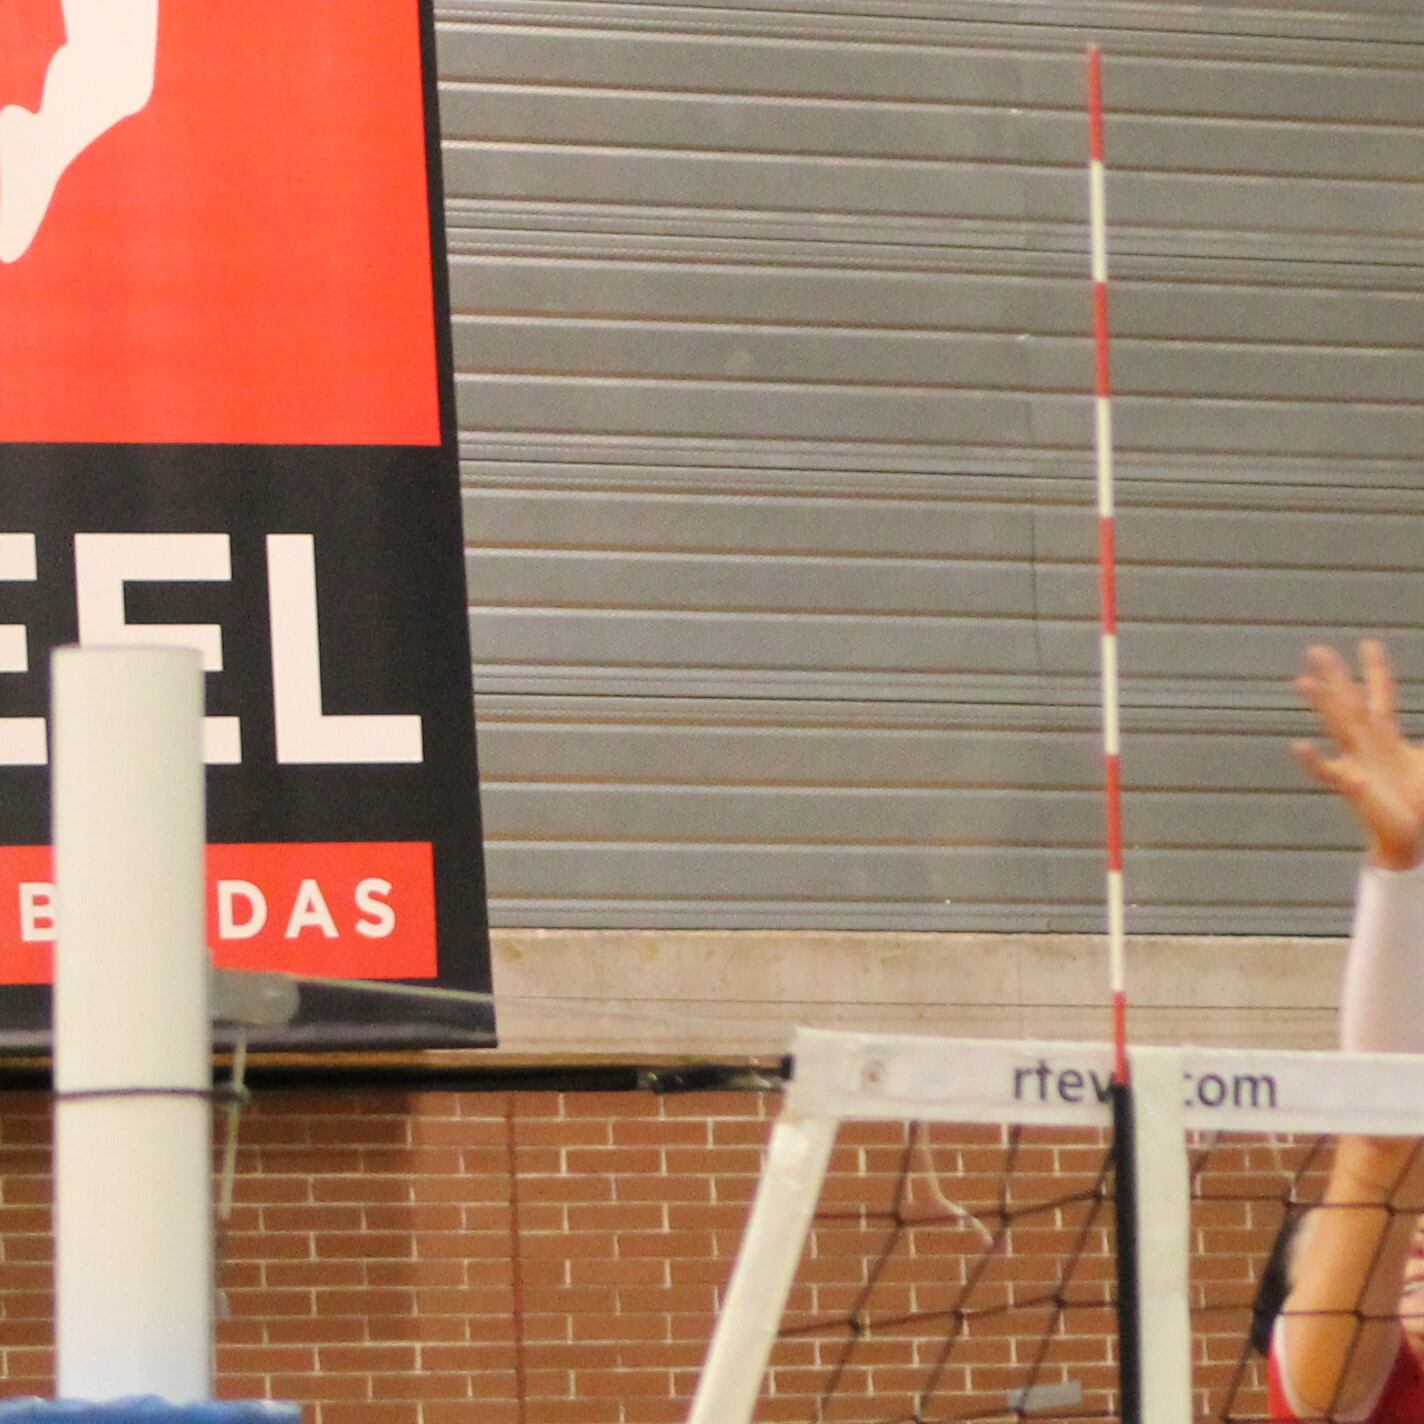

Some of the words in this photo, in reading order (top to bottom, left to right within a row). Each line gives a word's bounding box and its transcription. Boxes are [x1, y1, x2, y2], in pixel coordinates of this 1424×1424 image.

[0, 533, 423, 765] EL
[19, 877, 397, 943] BDAS
[1013, 1059, 1277, 1108] rfevom
